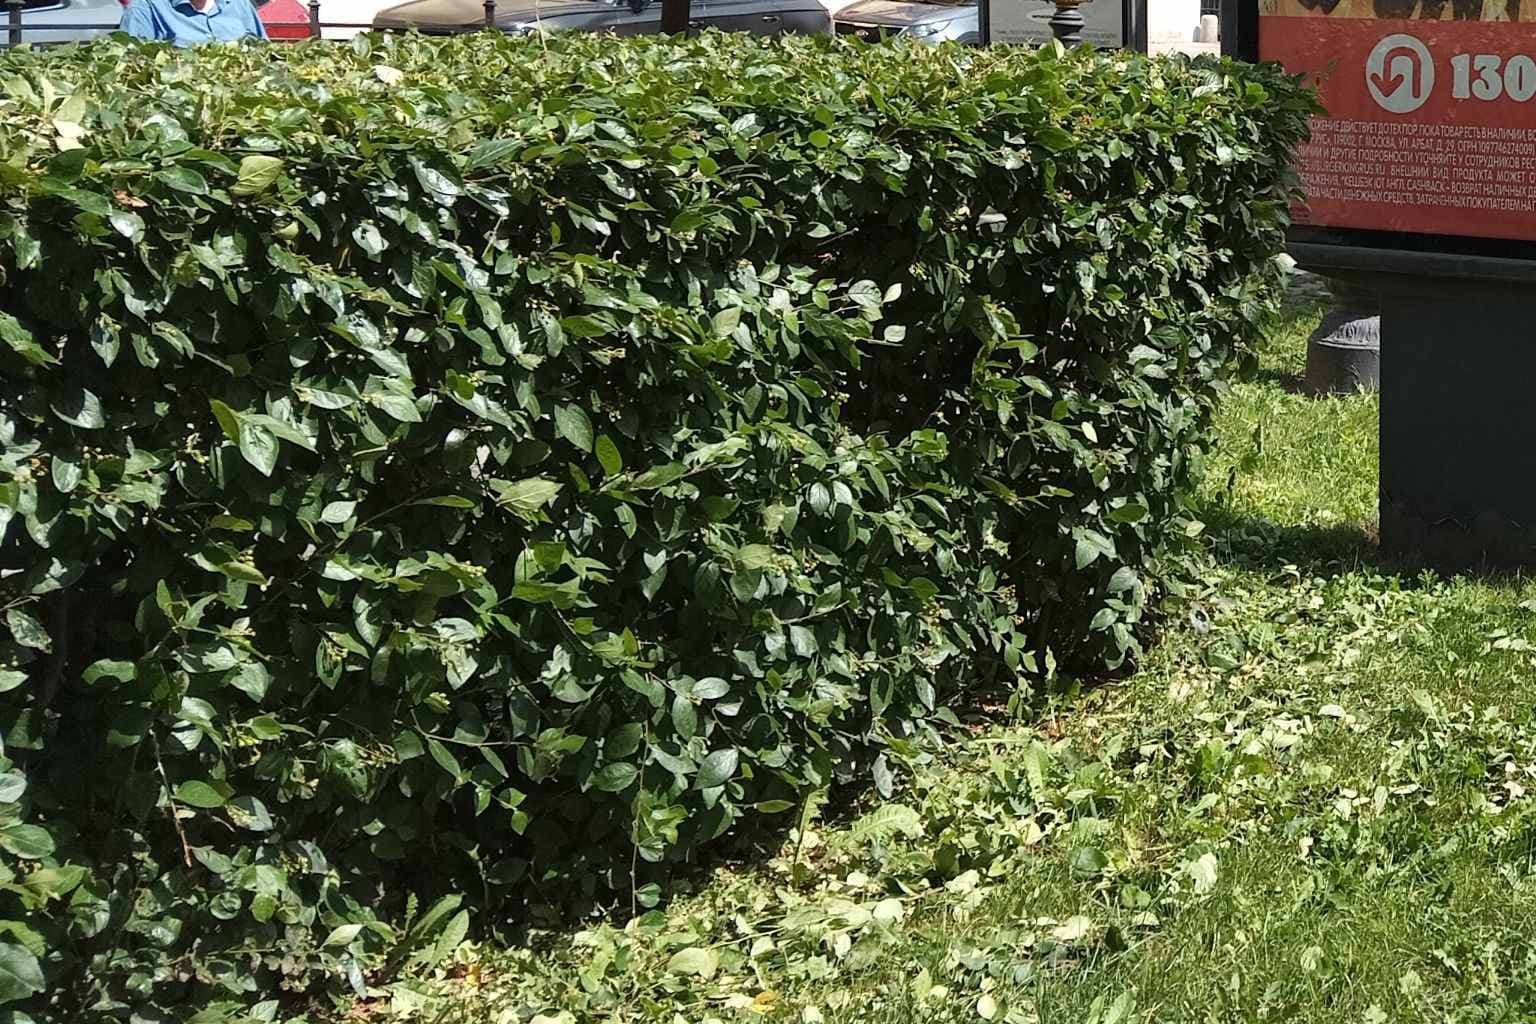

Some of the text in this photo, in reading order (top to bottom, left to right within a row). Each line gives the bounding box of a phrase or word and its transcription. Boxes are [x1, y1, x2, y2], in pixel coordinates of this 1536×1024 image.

[1358, 148, 1413, 164] ПОДРОБНОСТИ
[1465, 154, 1520, 170] СОТРУДНИКОВ
[1452, 167, 1493, 182] ПРОДУКТА
[1496, 169, 1525, 183] МОЖЕТ
